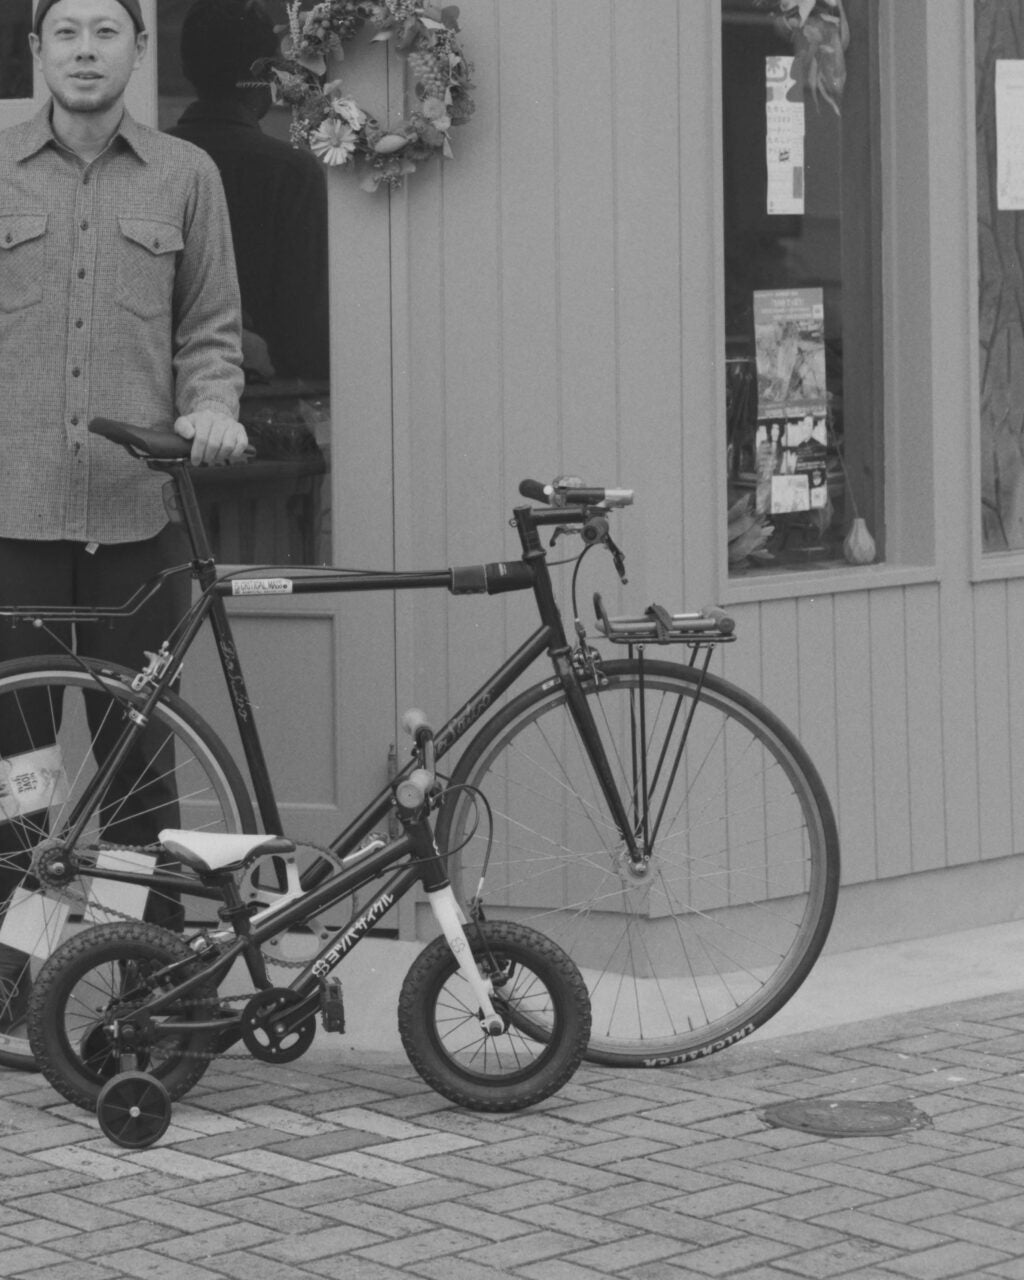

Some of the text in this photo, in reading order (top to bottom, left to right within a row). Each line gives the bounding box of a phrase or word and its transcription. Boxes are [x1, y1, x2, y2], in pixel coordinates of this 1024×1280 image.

[324, 893, 394, 964] ヨツバサイクル
